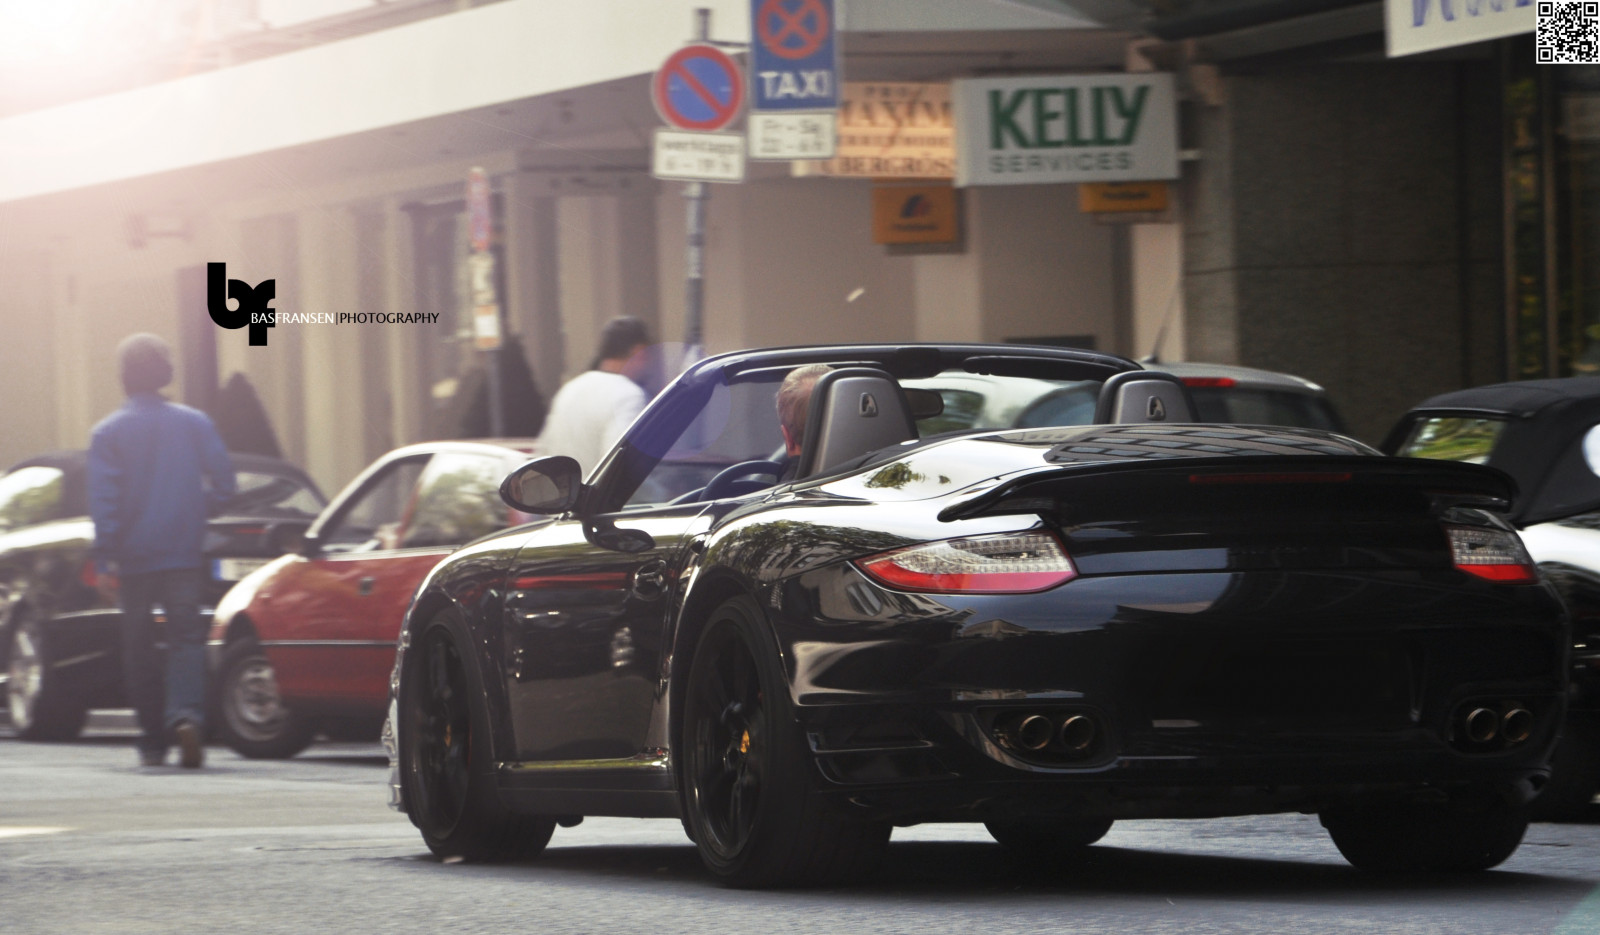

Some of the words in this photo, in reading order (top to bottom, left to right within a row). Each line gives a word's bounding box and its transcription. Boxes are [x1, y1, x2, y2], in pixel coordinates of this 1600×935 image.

[758, 70, 832, 99] TAXI
[987, 84, 1152, 150] KELLY
[989, 153, 1132, 173] SERVICES
